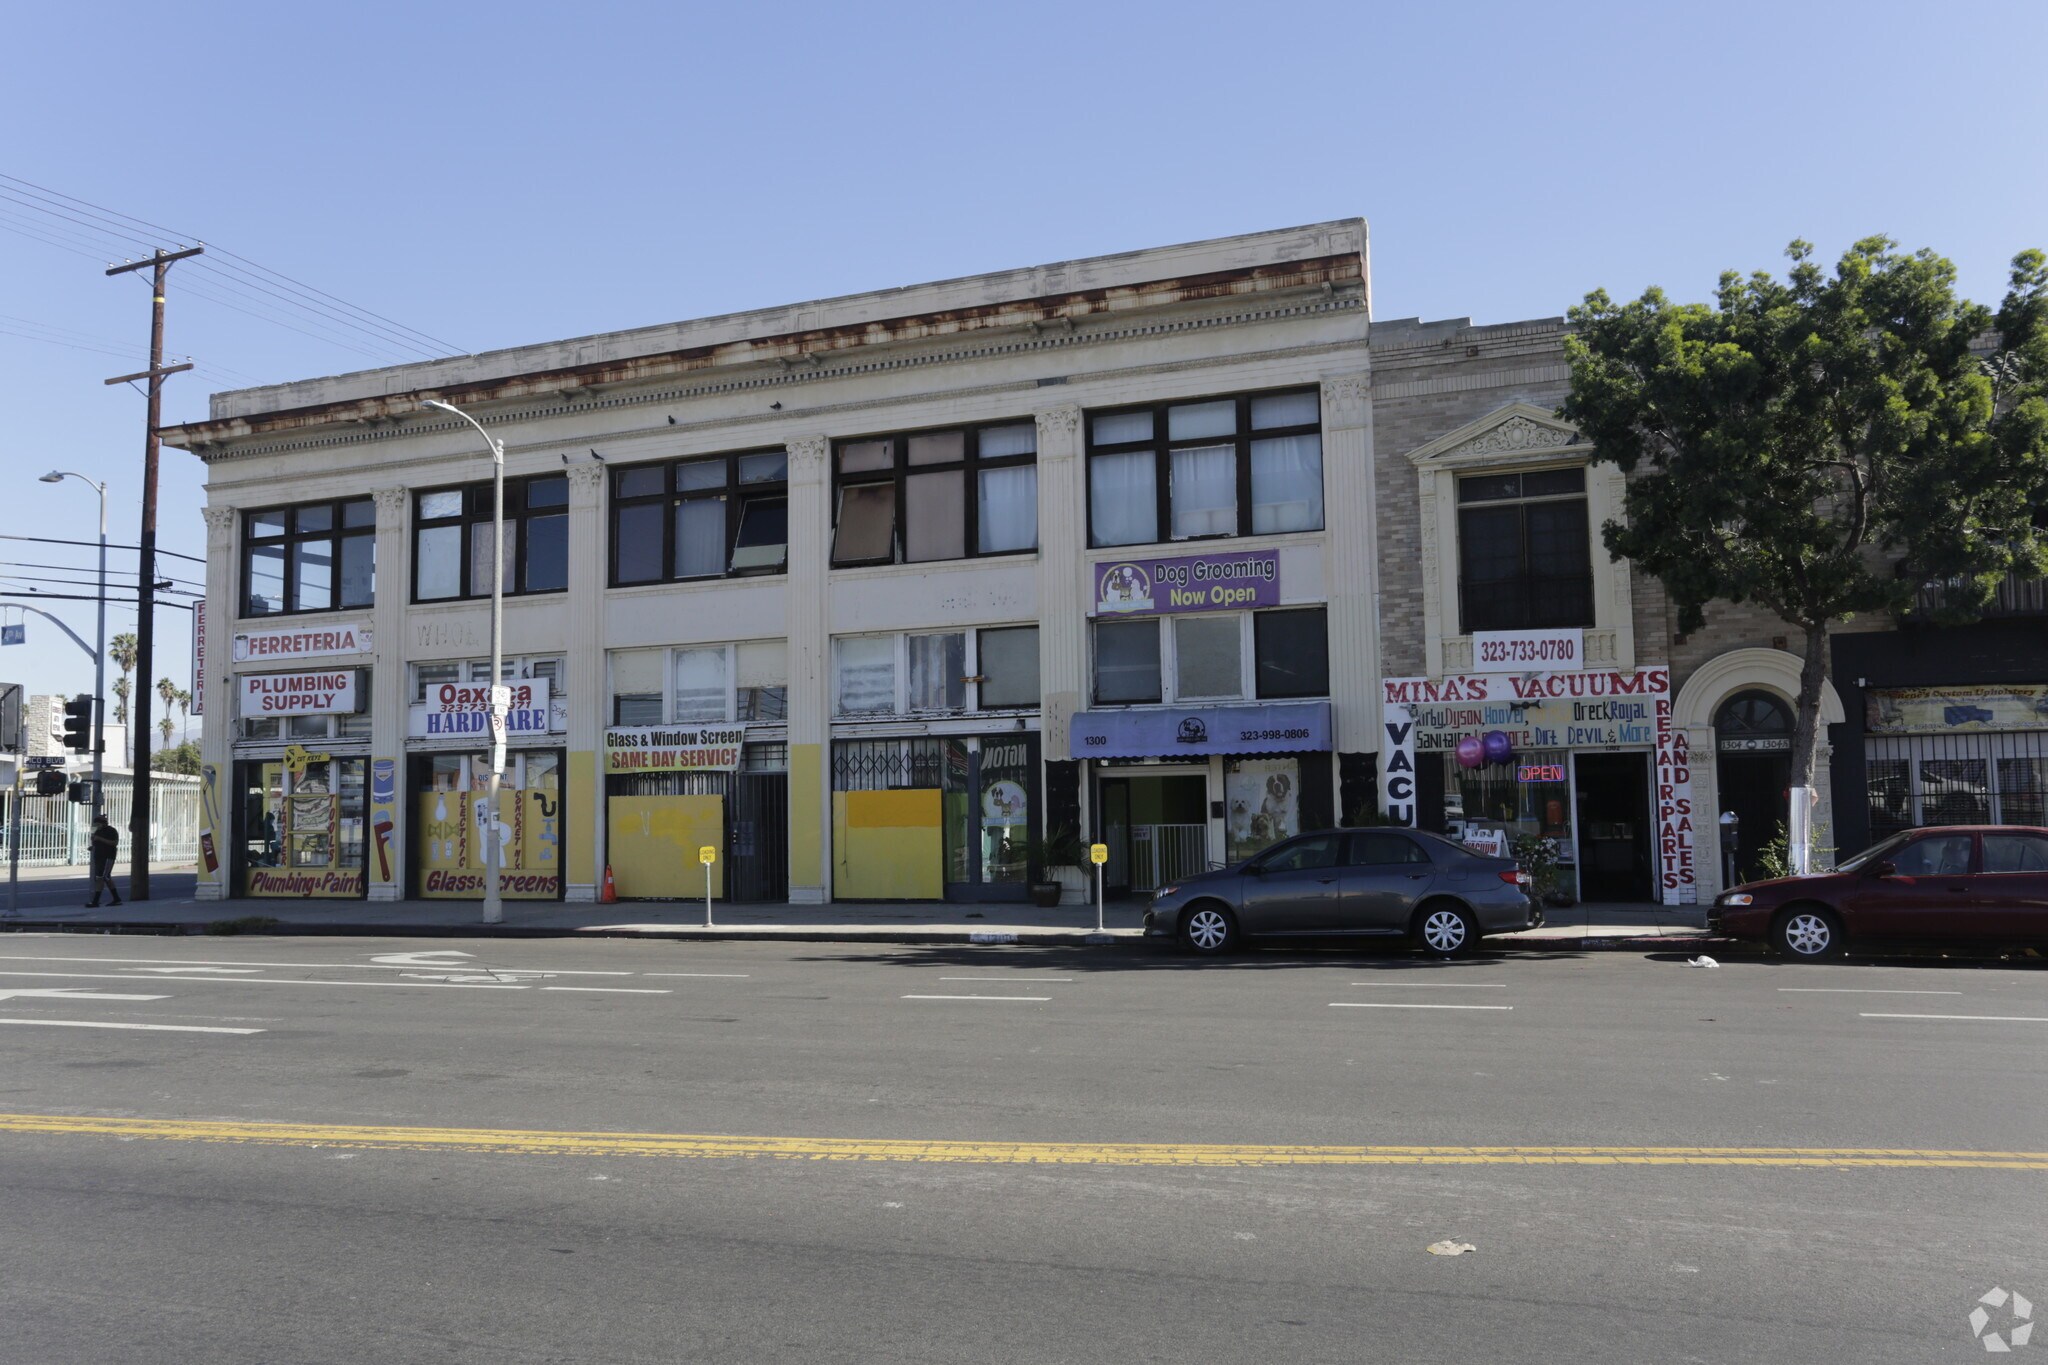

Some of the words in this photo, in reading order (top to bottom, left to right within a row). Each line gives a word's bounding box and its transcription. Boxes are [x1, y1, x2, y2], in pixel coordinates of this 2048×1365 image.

[1154, 563, 1189, 587] Dog
[1193, 557, 1276, 582] Grooming
[1170, 587, 1206, 606] Now
[1210, 585, 1256, 606] Open
[249, 631, 356, 655] FERRETERIA
[1481, 639, 1574, 662] 323-733-0780
[249, 674, 347, 694] PLUMBING
[1384, 675, 1488, 703] MINA'S
[1508, 670, 1669, 698] VACUUMS
[262, 693, 336, 711] SUPPLY
[427, 709, 546, 734] HARDARE
[607, 732, 638, 747] Glass
[640, 733, 649, 747] &
[650, 731, 698, 746] Window
[700, 729, 742, 745] Screen
[1084, 735, 1107, 746] 1300
[1240, 729, 1310, 741] 323-998-0806
[1722, 740, 1741, 749] 1304
[611, 751, 648, 768] SAME
[651, 750, 677, 767] DAY
[1656, 699, 1674, 800] REPAIR
[1673, 733, 1690, 784] AND
[1520, 766, 1562, 780] OPEN
[328, 794, 336, 863] TOOLS
[514, 790, 522, 846] CONCRET
[1661, 806, 1678, 889] PARTS
[1676, 799, 1694, 884] SALES
[251, 871, 315, 897] Plumbing
[315, 877, 321, 887] &
[321, 871, 363, 893] Paint
[426, 870, 476, 892] Glass
